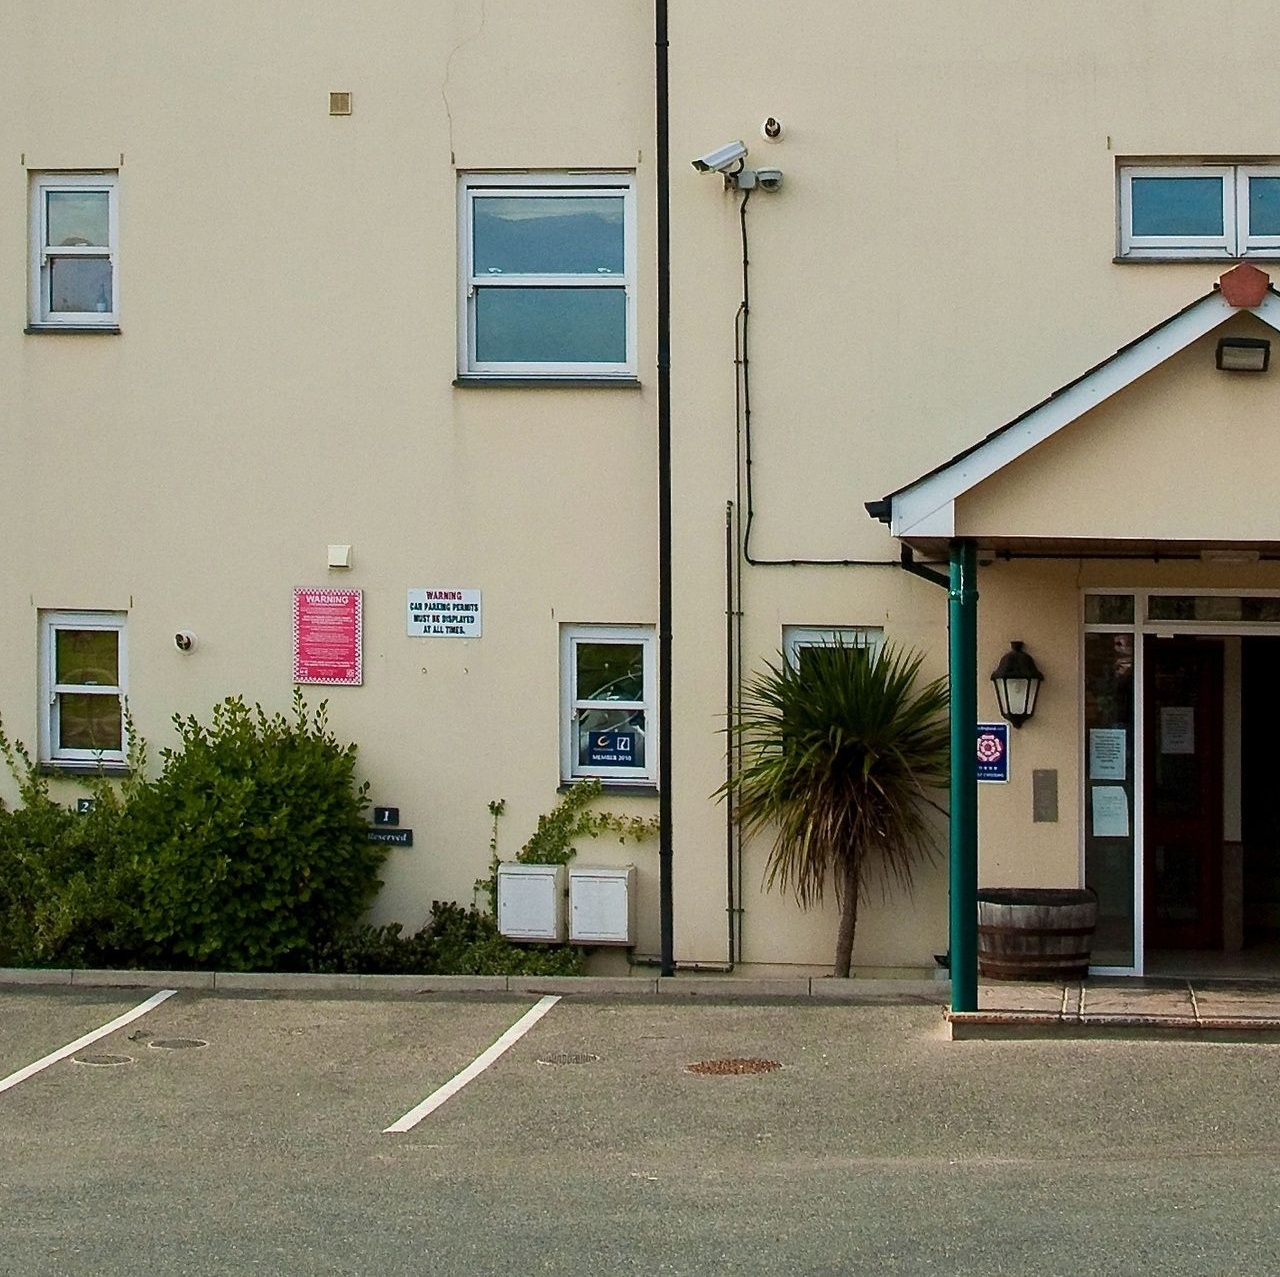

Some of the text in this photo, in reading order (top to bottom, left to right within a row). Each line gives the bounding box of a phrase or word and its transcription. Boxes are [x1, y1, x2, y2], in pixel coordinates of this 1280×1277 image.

[306, 595, 349, 604] WARNING
[426, 591, 462, 600] WARNING
[410, 602, 479, 612] CAR PARKING PERMITS
[413, 614, 475, 624] MUST BE DISPLAYED
[423, 625, 432, 634] AT
[433, 625, 444, 634] ALL
[80, 802, 89, 812] 2
[368, 833, 407, 842] Reserved
